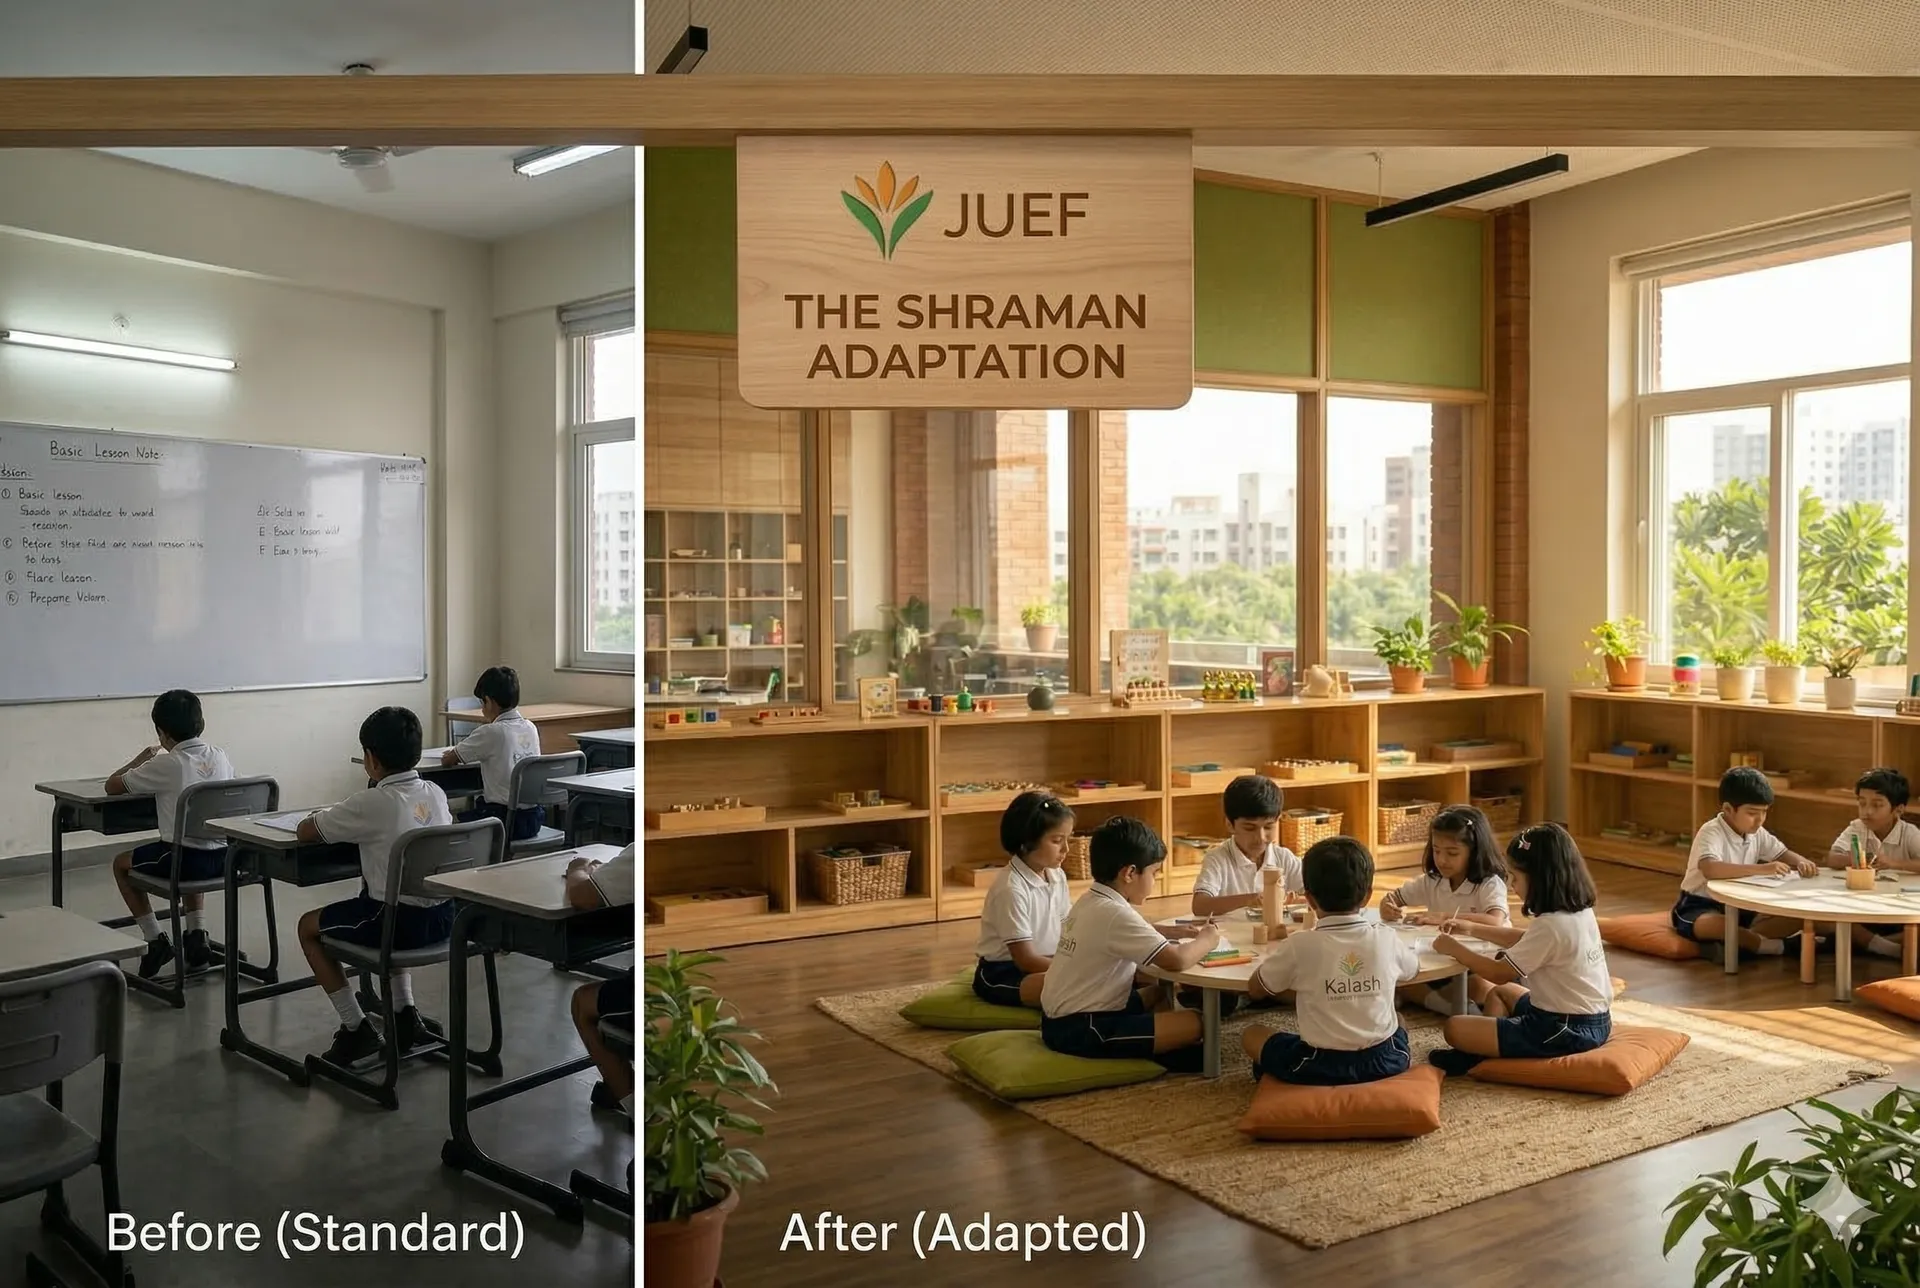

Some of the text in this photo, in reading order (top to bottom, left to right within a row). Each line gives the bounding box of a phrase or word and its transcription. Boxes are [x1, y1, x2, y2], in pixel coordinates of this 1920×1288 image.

[943, 192, 1090, 239] JUEF
[784, 293, 1147, 331] THE SHRAMAN
[806, 343, 1126, 380] ADAPTATION
[50, 440, 83, 457] Basic
[95, 443, 130, 459] Lesson
[19, 487, 45, 500] Basic
[1325, 975, 1381, 994] Kalash
